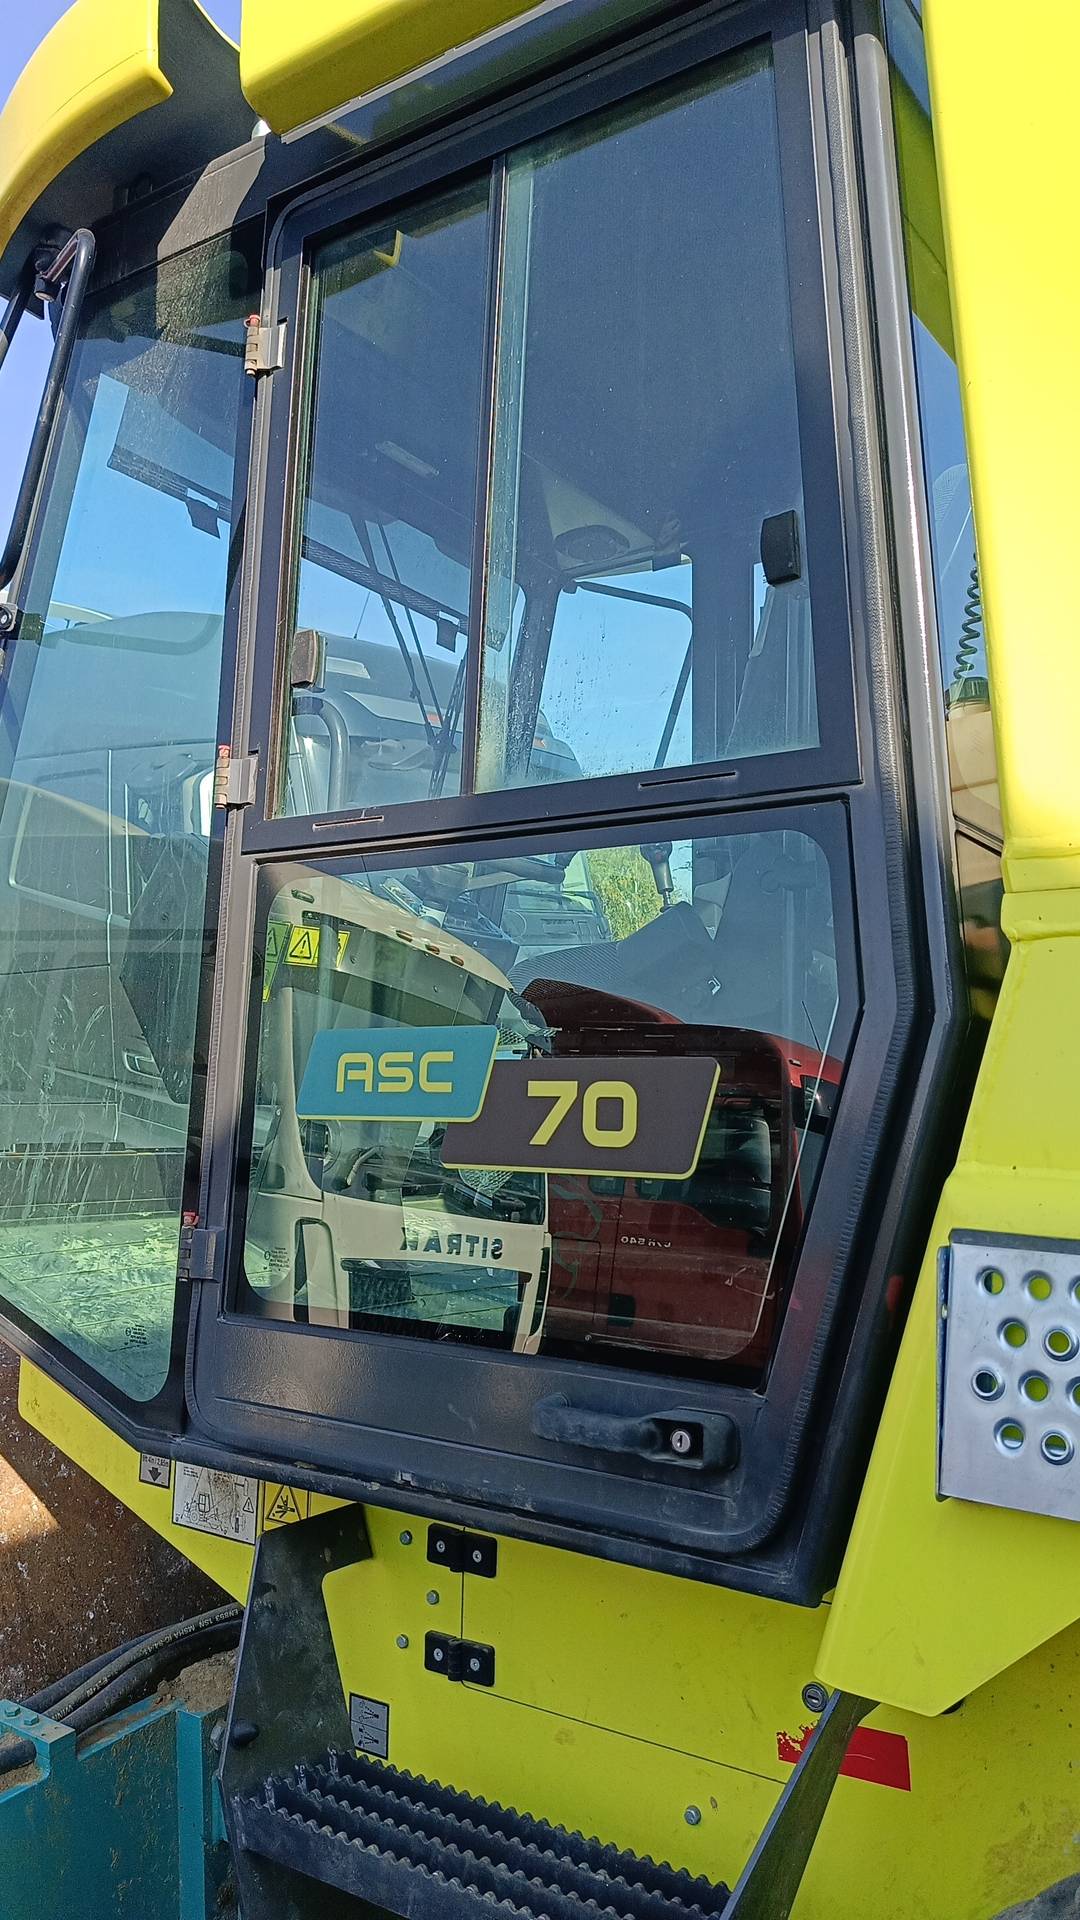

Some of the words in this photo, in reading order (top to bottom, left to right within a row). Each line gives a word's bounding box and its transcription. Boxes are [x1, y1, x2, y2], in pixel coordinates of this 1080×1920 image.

[336, 1050, 454, 1093] ASC
[527, 1080, 639, 1148] 70
[215, 1608, 239, 1620] EN853
[174, 1624, 196, 1639] MSHA
